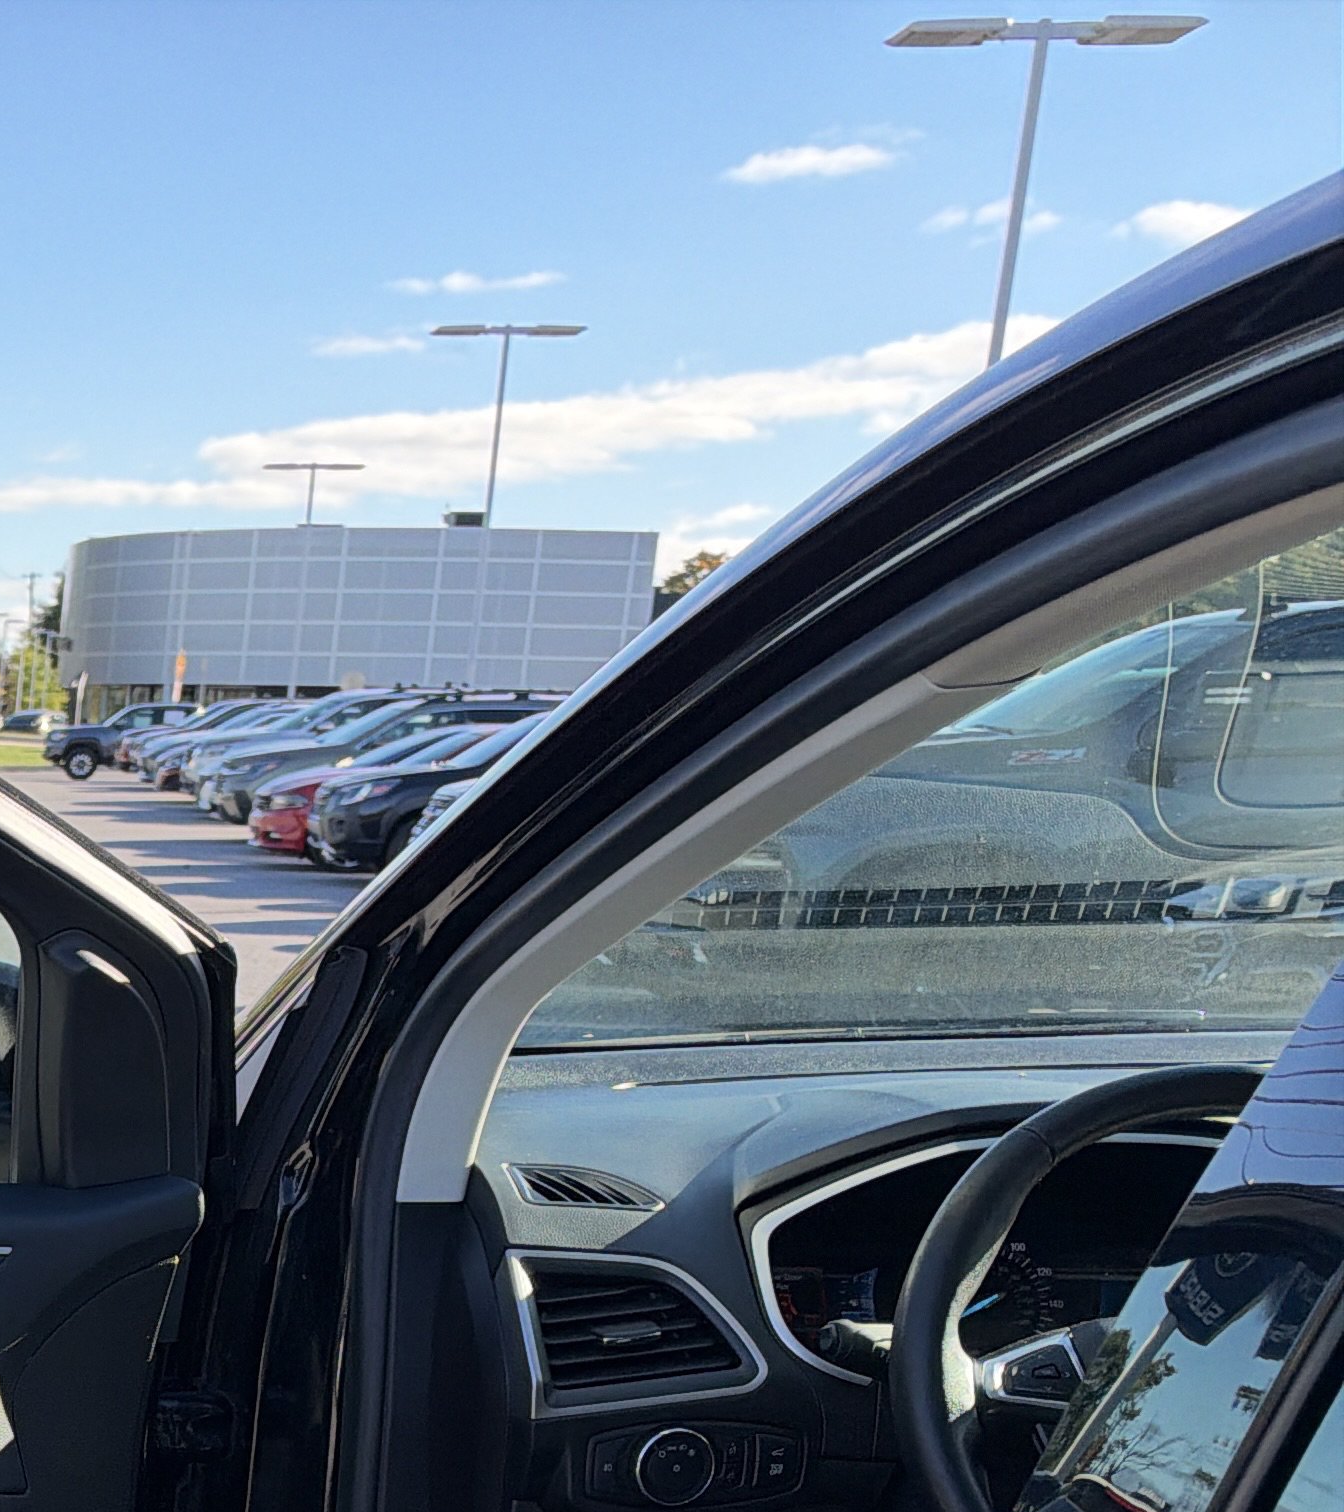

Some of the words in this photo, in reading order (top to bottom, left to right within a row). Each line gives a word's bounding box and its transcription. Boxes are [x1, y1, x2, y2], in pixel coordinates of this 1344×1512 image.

[1011, 1242, 1026, 1252] 100
[1036, 1267, 1052, 1276] 120
[1049, 1299, 1064, 1308] 140
